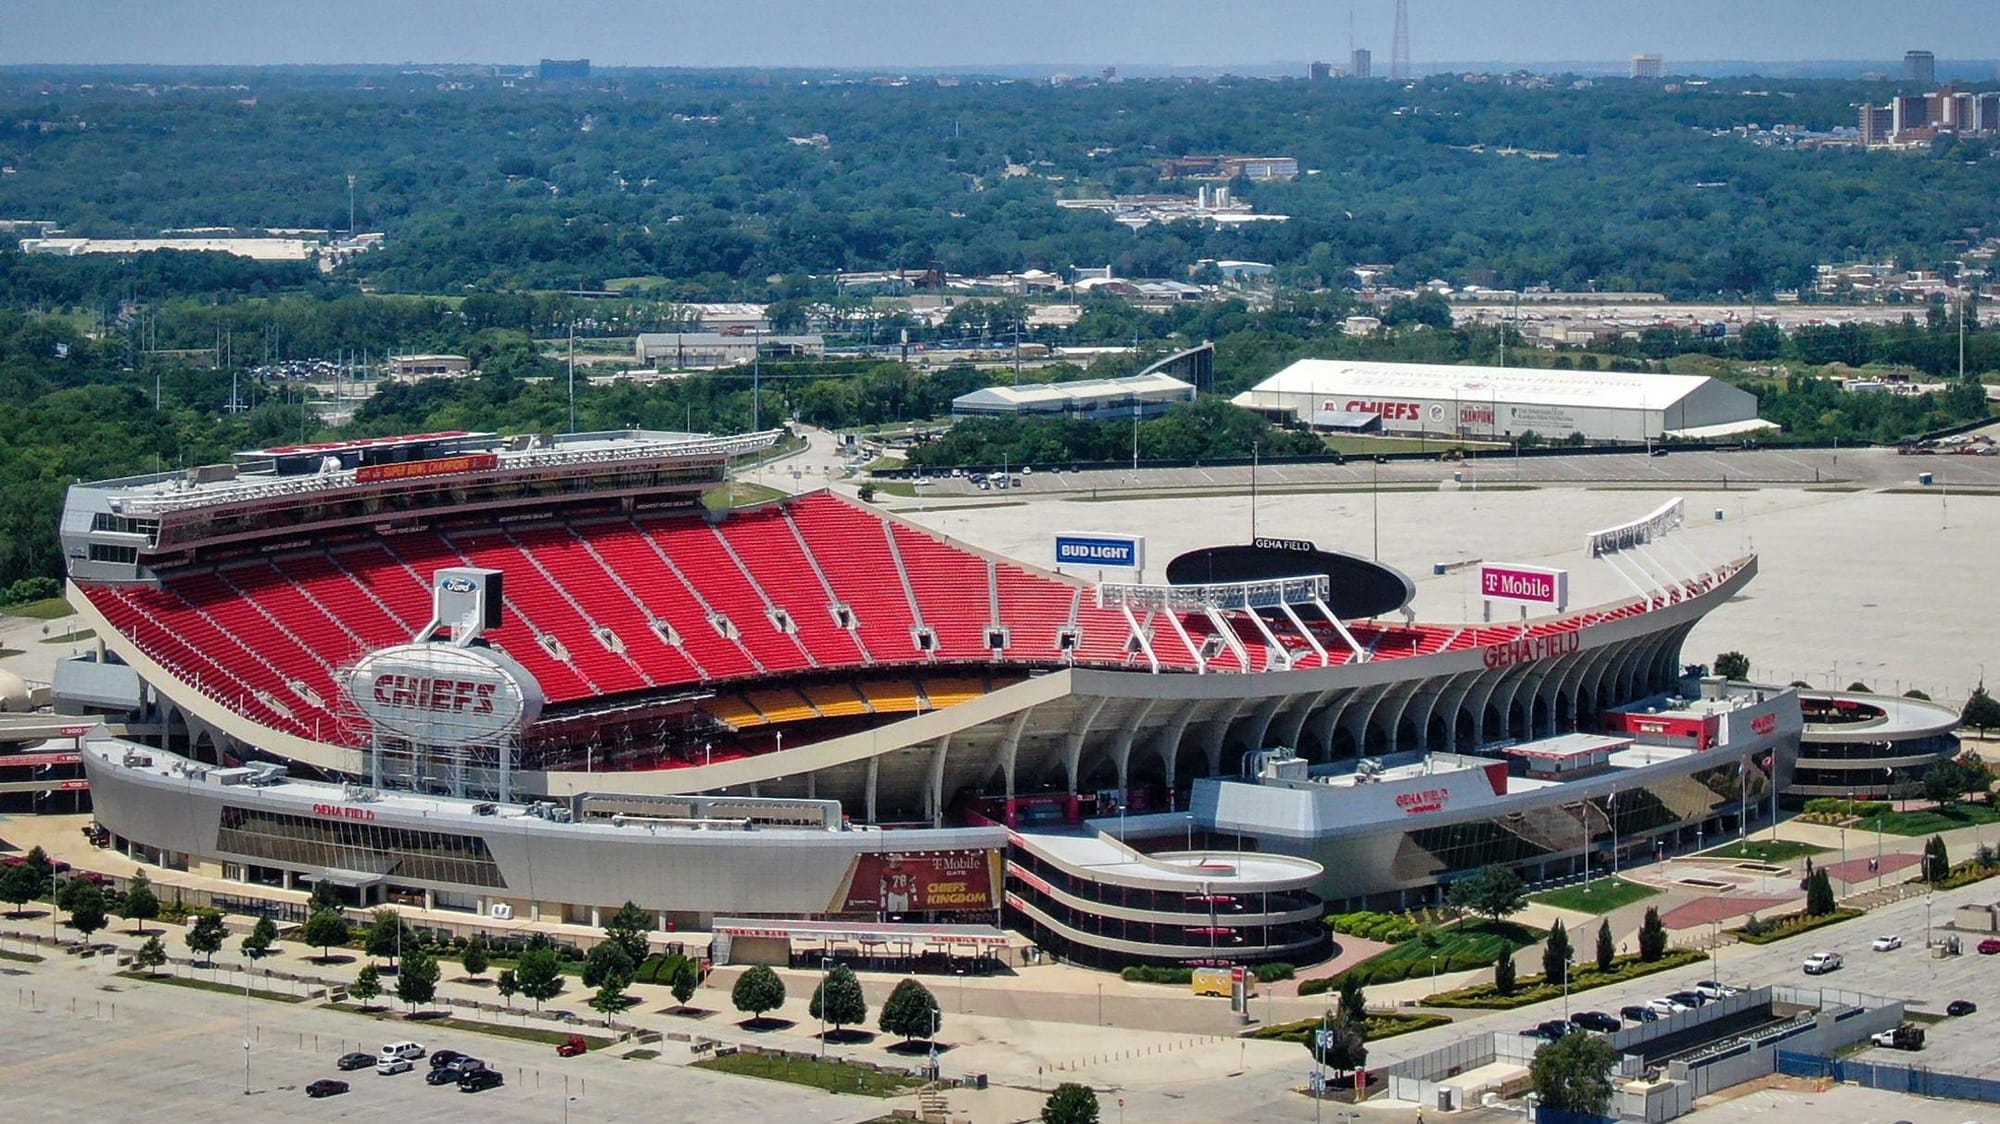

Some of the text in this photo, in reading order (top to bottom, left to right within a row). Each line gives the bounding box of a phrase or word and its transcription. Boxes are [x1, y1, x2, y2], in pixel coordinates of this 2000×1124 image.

[1345, 400, 1420, 420] CHIEFS
[428, 458, 469, 474] CHAMPIONS
[1061, 544, 1129, 560] BUD LIGHT
[1255, 538, 1310, 552] GEHA FIELD
[447, 578, 470, 592] Ford
[1483, 631, 1580, 669] GEHA FIELD
[374, 674, 497, 716] CHIEFS
[313, 803, 375, 821] GEHA FIELD
[927, 882, 967, 893] CHIEFS
[927, 892, 987, 904] KINGDOM
